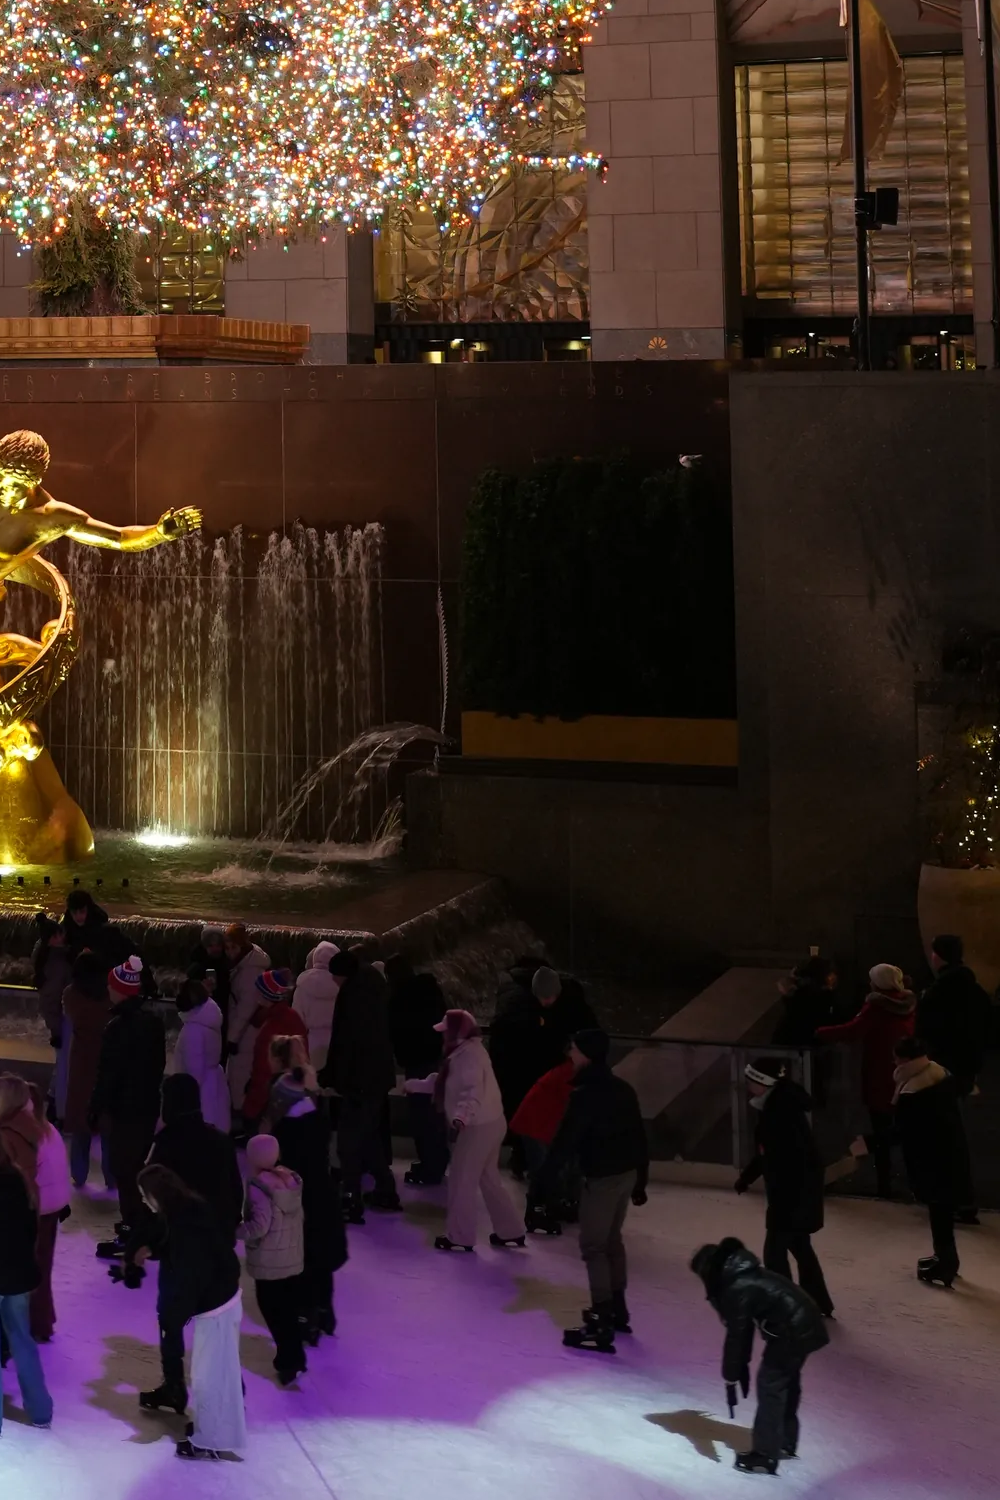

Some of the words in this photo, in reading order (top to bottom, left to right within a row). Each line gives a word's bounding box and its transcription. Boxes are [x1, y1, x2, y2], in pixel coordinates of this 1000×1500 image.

[101, 373, 160, 386] ART
[77, 390, 84, 401] A
[127, 389, 237, 401] MEANS
[559, 382, 655, 398] ENDS
